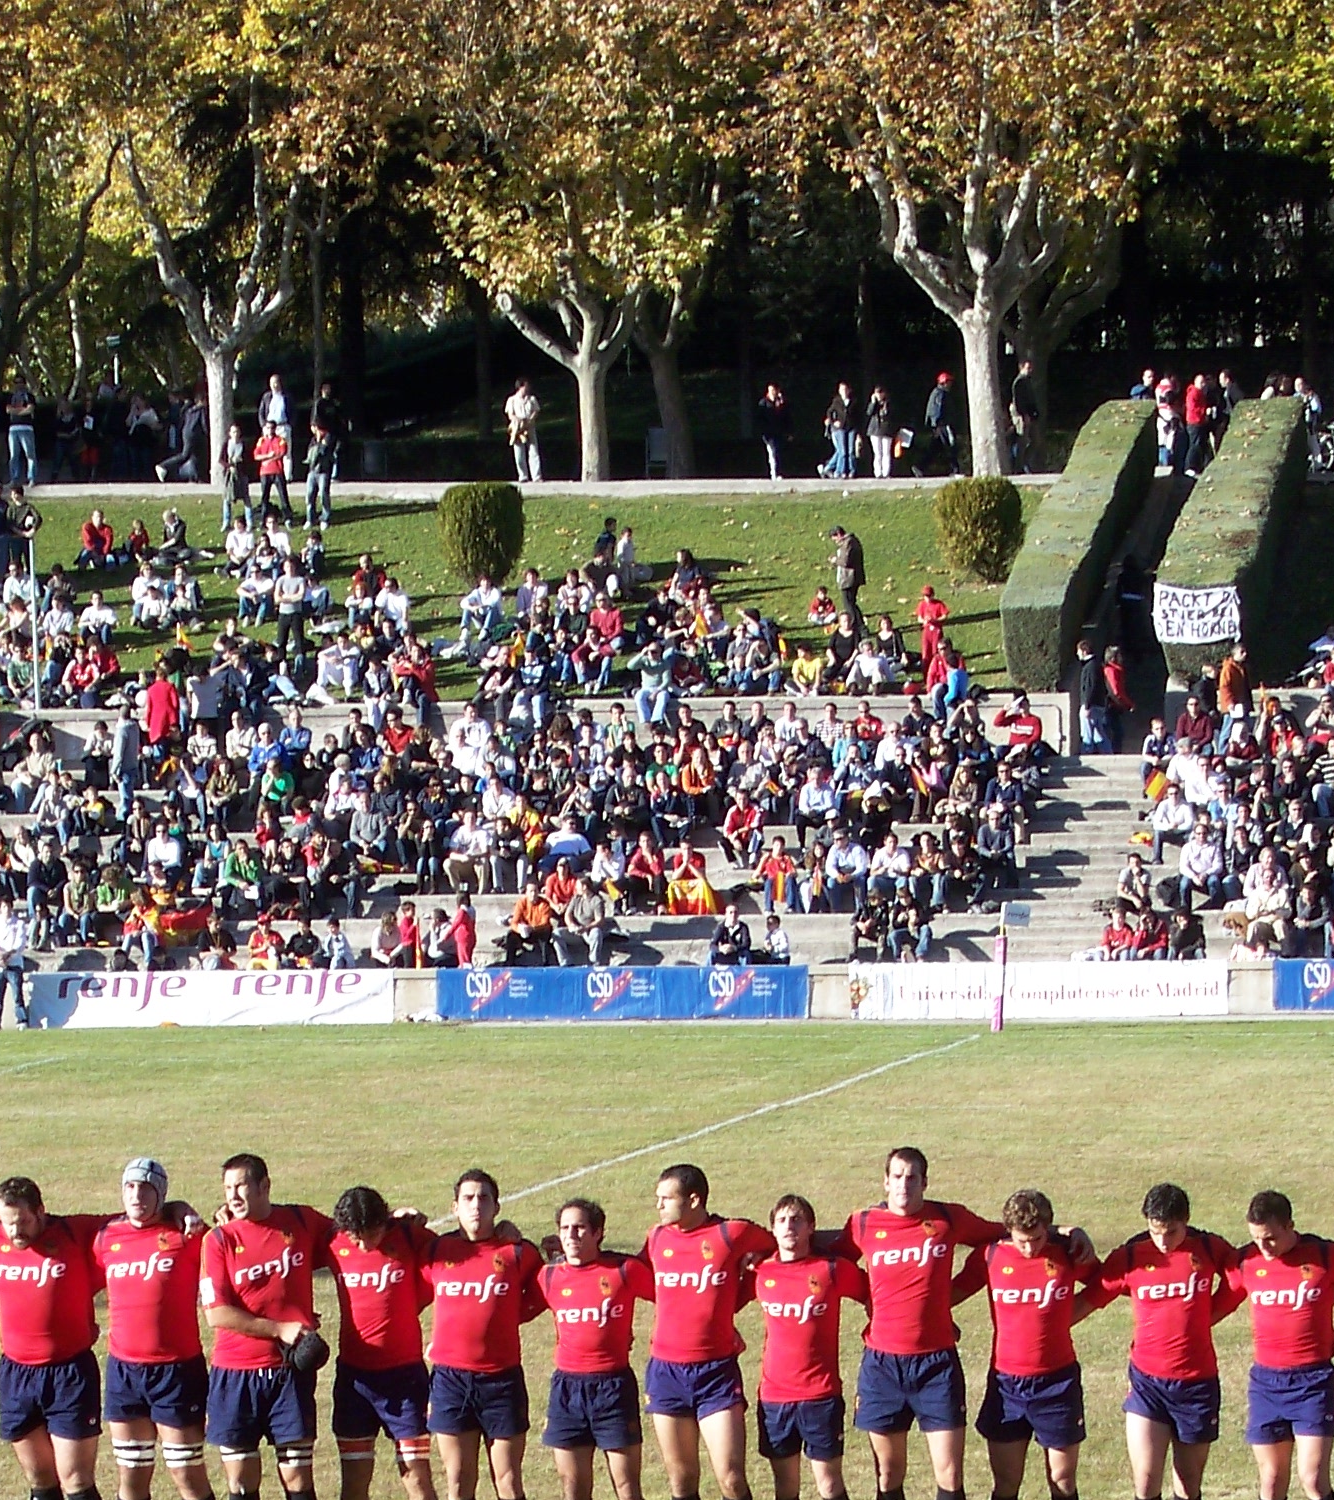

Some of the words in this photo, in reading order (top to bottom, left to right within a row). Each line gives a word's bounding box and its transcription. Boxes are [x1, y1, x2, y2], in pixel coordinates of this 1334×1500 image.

[1159, 590, 1214, 608] PACKT
[232, 969, 362, 1007] renfe
[466, 972, 492, 998] CSD
[587, 972, 613, 998] CSD
[708, 971, 735, 997] CSD
[1303, 962, 1331, 989] CSD
[58, 971, 187, 1011] renfe
[899, 985, 994, 1001] Universida
[1156, 981, 1219, 997] Madrid
[106, 1251, 174, 1281] renfe
[234, 1246, 304, 1285] renfe
[871, 1236, 947, 1267] renfe
[338, 1262, 405, 1293] renfe
[436, 1274, 509, 1303] renfe
[655, 1264, 727, 1293] renfe
[1136, 1272, 1210, 1302] renfe
[761, 1294, 828, 1324] renfe
[992, 1279, 1069, 1309] renfe
[1250, 1279, 1322, 1311] renfe
[556, 1297, 624, 1328] renfe
